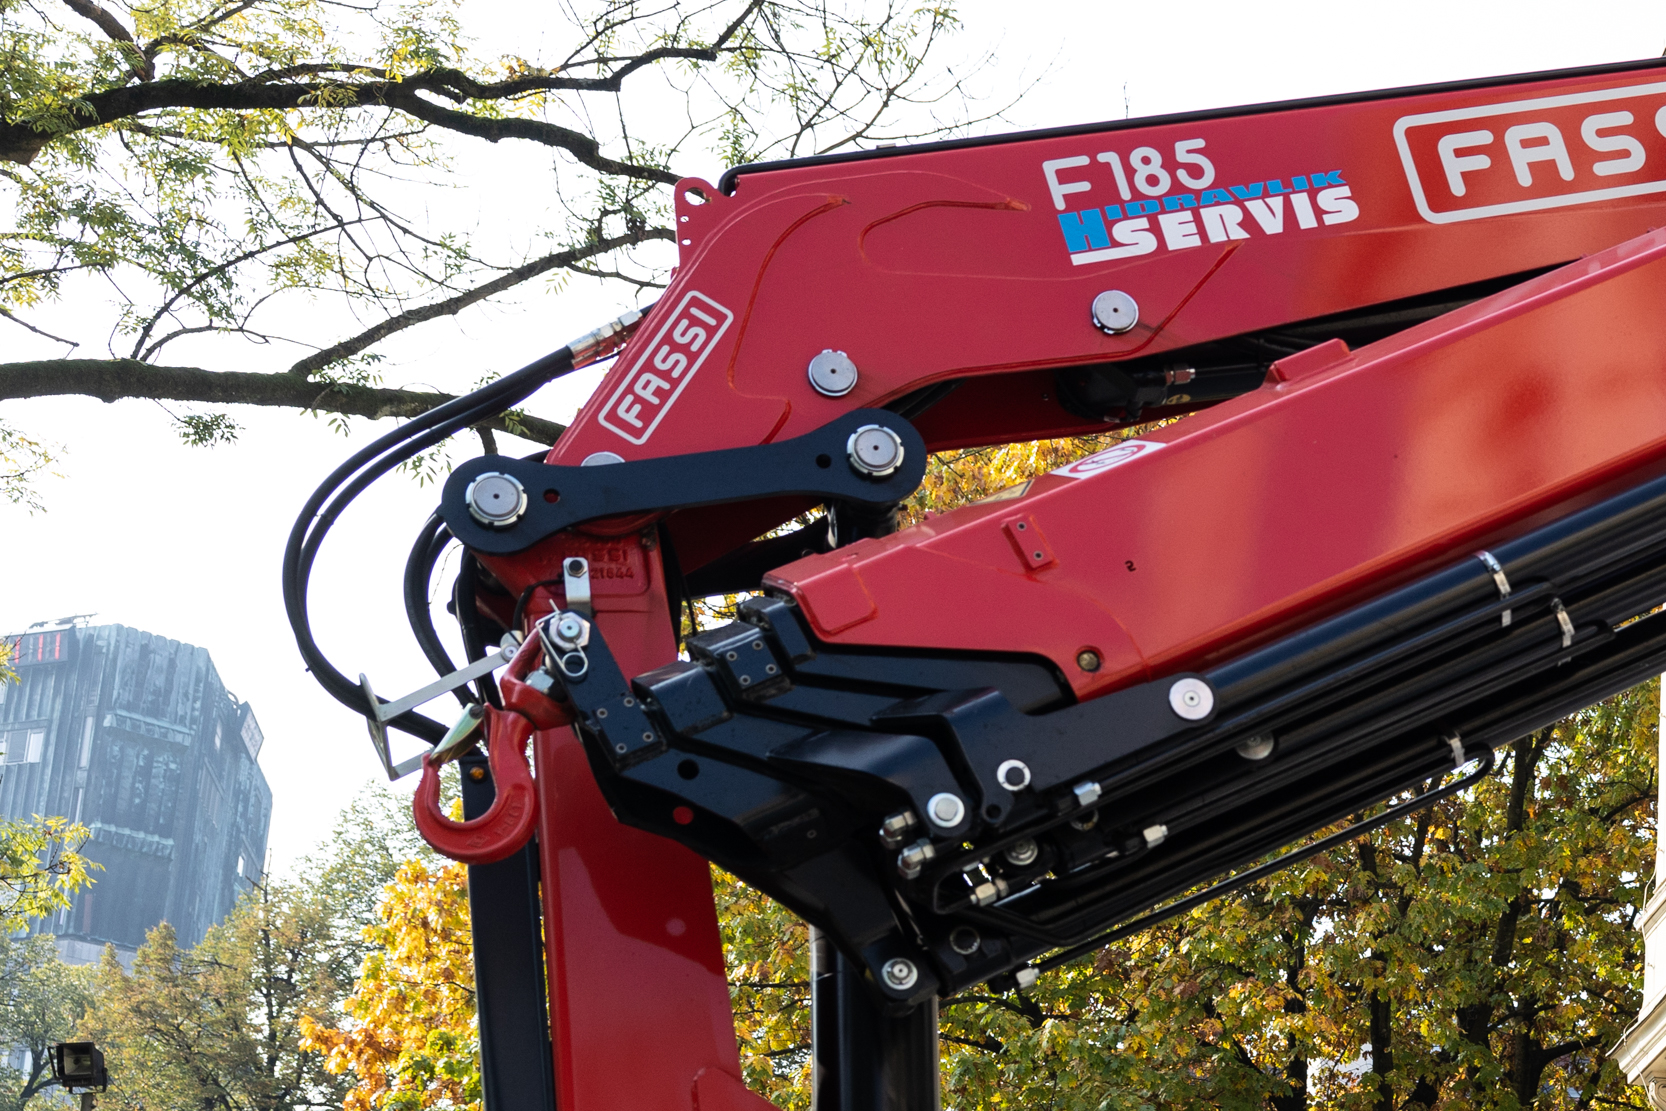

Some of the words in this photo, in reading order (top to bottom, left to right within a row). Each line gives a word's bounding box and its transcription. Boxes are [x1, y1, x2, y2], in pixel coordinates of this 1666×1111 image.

[1042, 138, 1215, 211] F185
[1070, 185, 1360, 266] SERVIS
[617, 307, 717, 428] FASSI
